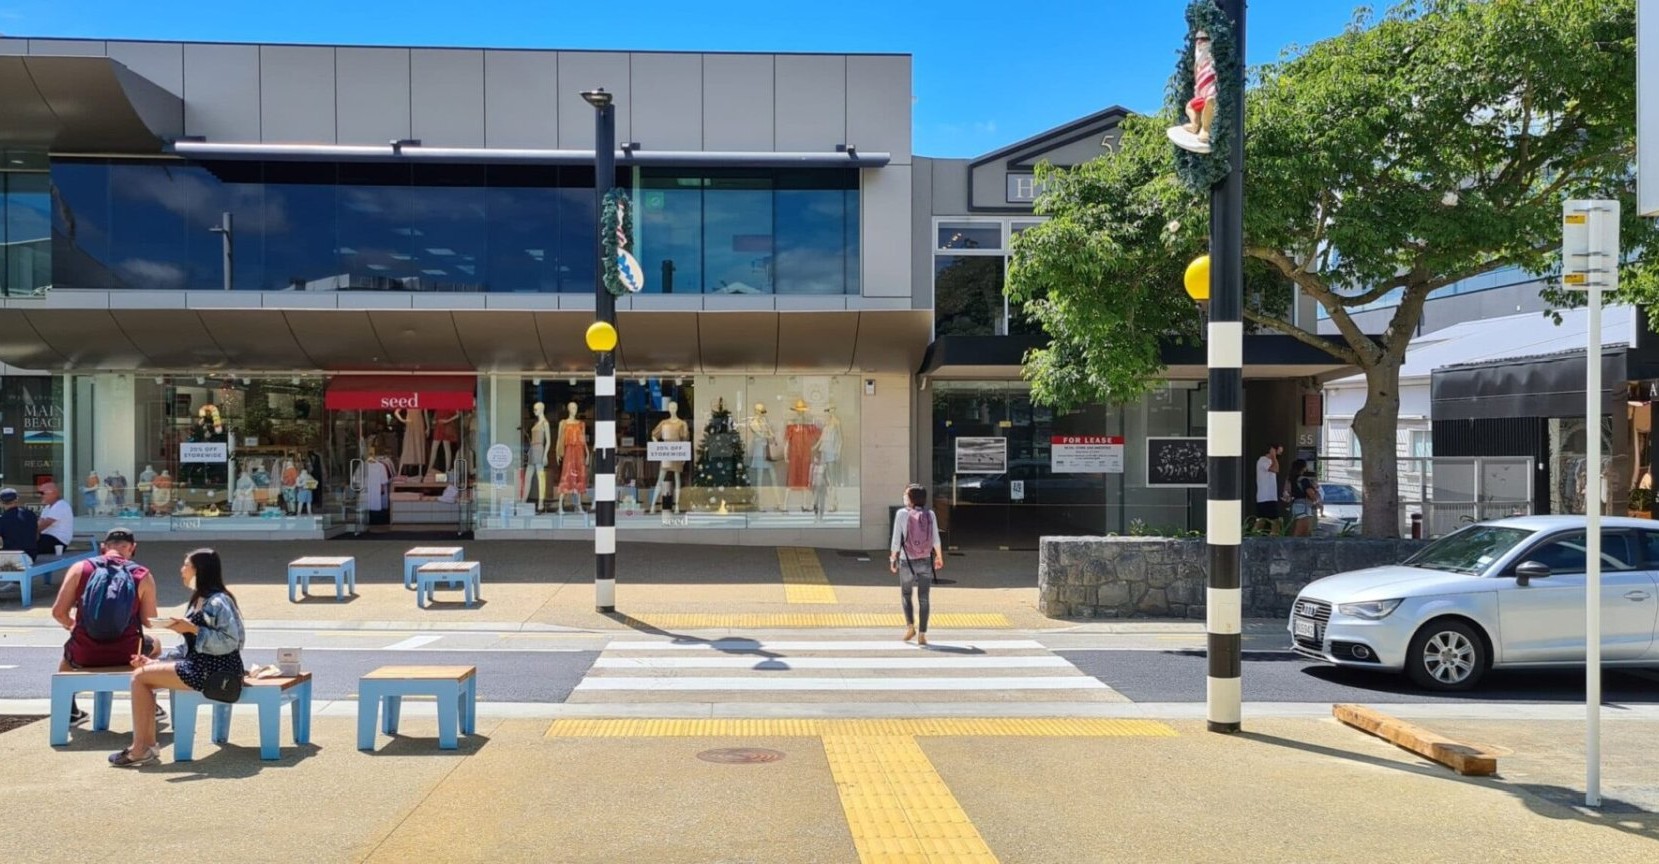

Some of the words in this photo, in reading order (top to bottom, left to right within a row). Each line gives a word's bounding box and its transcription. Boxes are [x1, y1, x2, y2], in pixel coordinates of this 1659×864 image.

[381, 392, 418, 408] seed
[1063, 436, 1081, 444] FOR
[1084, 436, 1113, 444] LEASE
[1300, 434, 1313, 445] 55
[662, 514, 688, 526] seed
